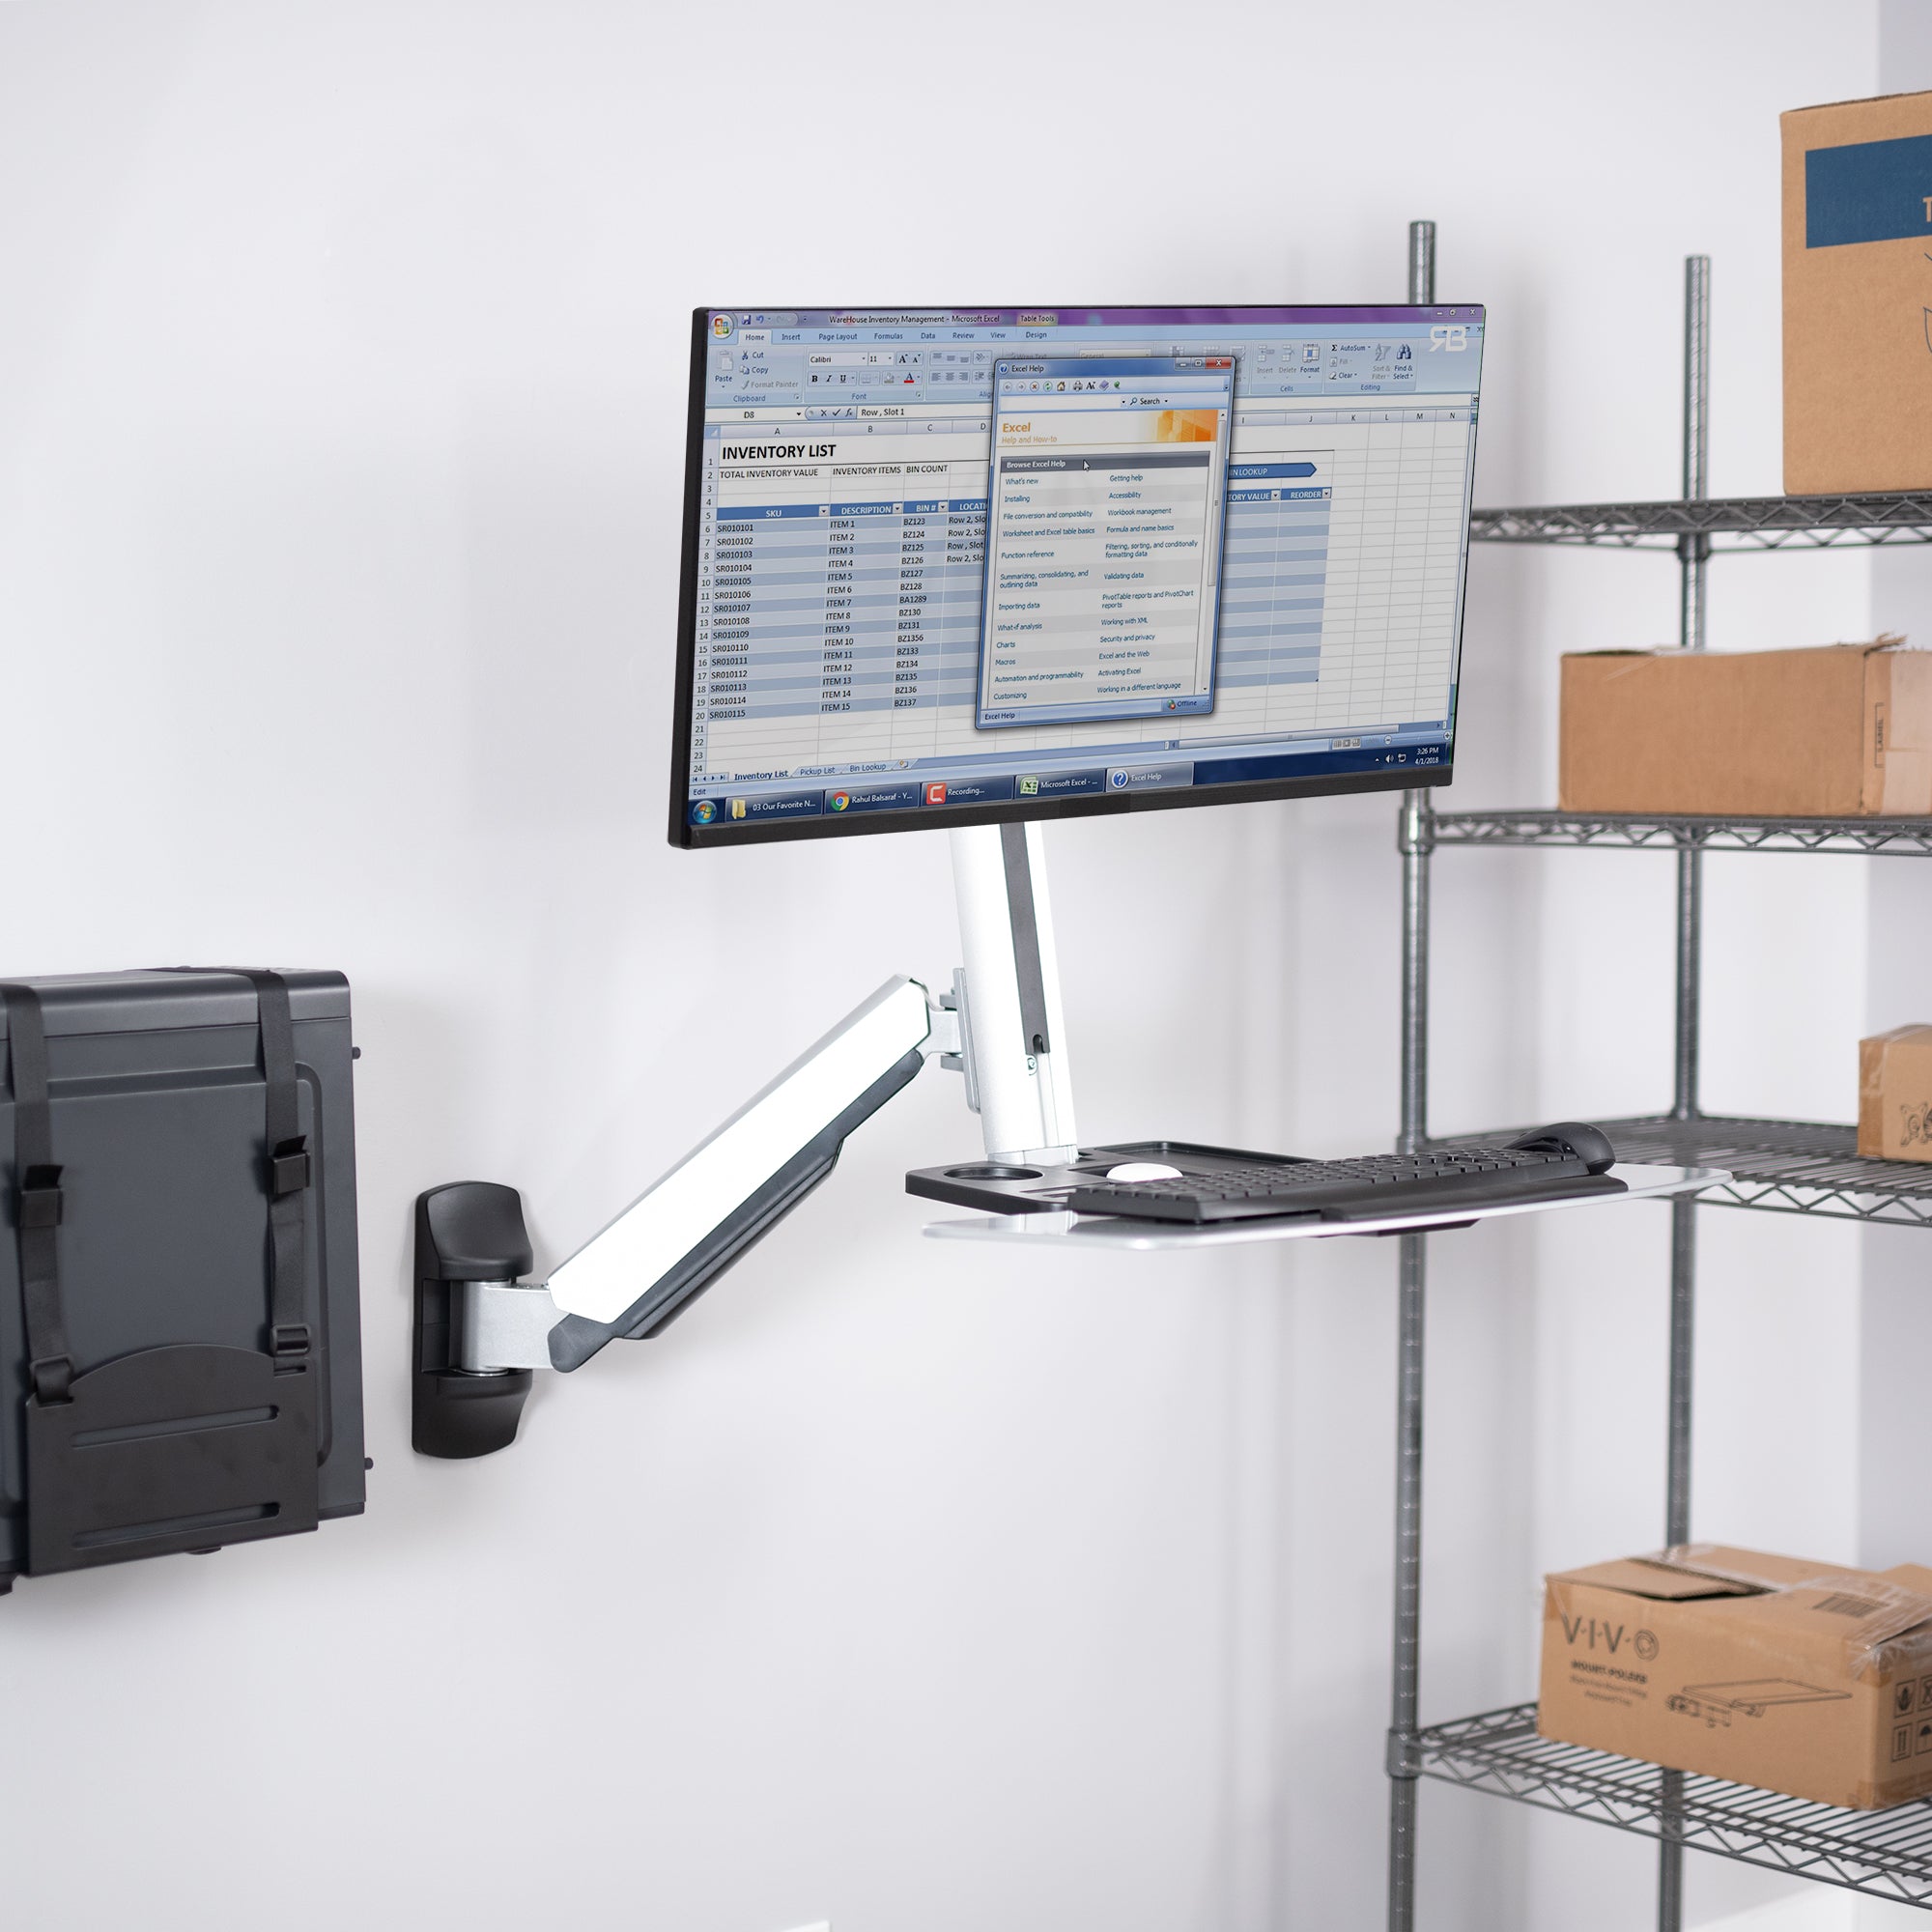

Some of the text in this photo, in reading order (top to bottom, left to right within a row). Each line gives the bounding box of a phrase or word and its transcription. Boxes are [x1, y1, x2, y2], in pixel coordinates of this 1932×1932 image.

[830, 315, 867, 325] WareHouse
[869, 315, 898, 325] Inventory
[900, 315, 945, 325] Management
[874, 331, 903, 340] Formulas
[1003, 422, 1031, 433] Excel
[723, 444, 837, 460] INVENTORY LIST
[747, 469, 792, 478] INVENTORY
[841, 506, 892, 515] DESCRIPTION
[717, 537, 753, 546] SR010102
[716, 551, 753, 559] SR010103
[714, 617, 750, 626] SR010108
[712, 657, 748, 666] SR010111
[711, 670, 748, 679] SR010112
[710, 696, 746, 705] SR010114
[709, 710, 746, 719] SR010115
[862, 763, 886, 772] Lookup
[734, 771, 773, 781] Inventory
[1041, 780, 1070, 788] Microsoft
